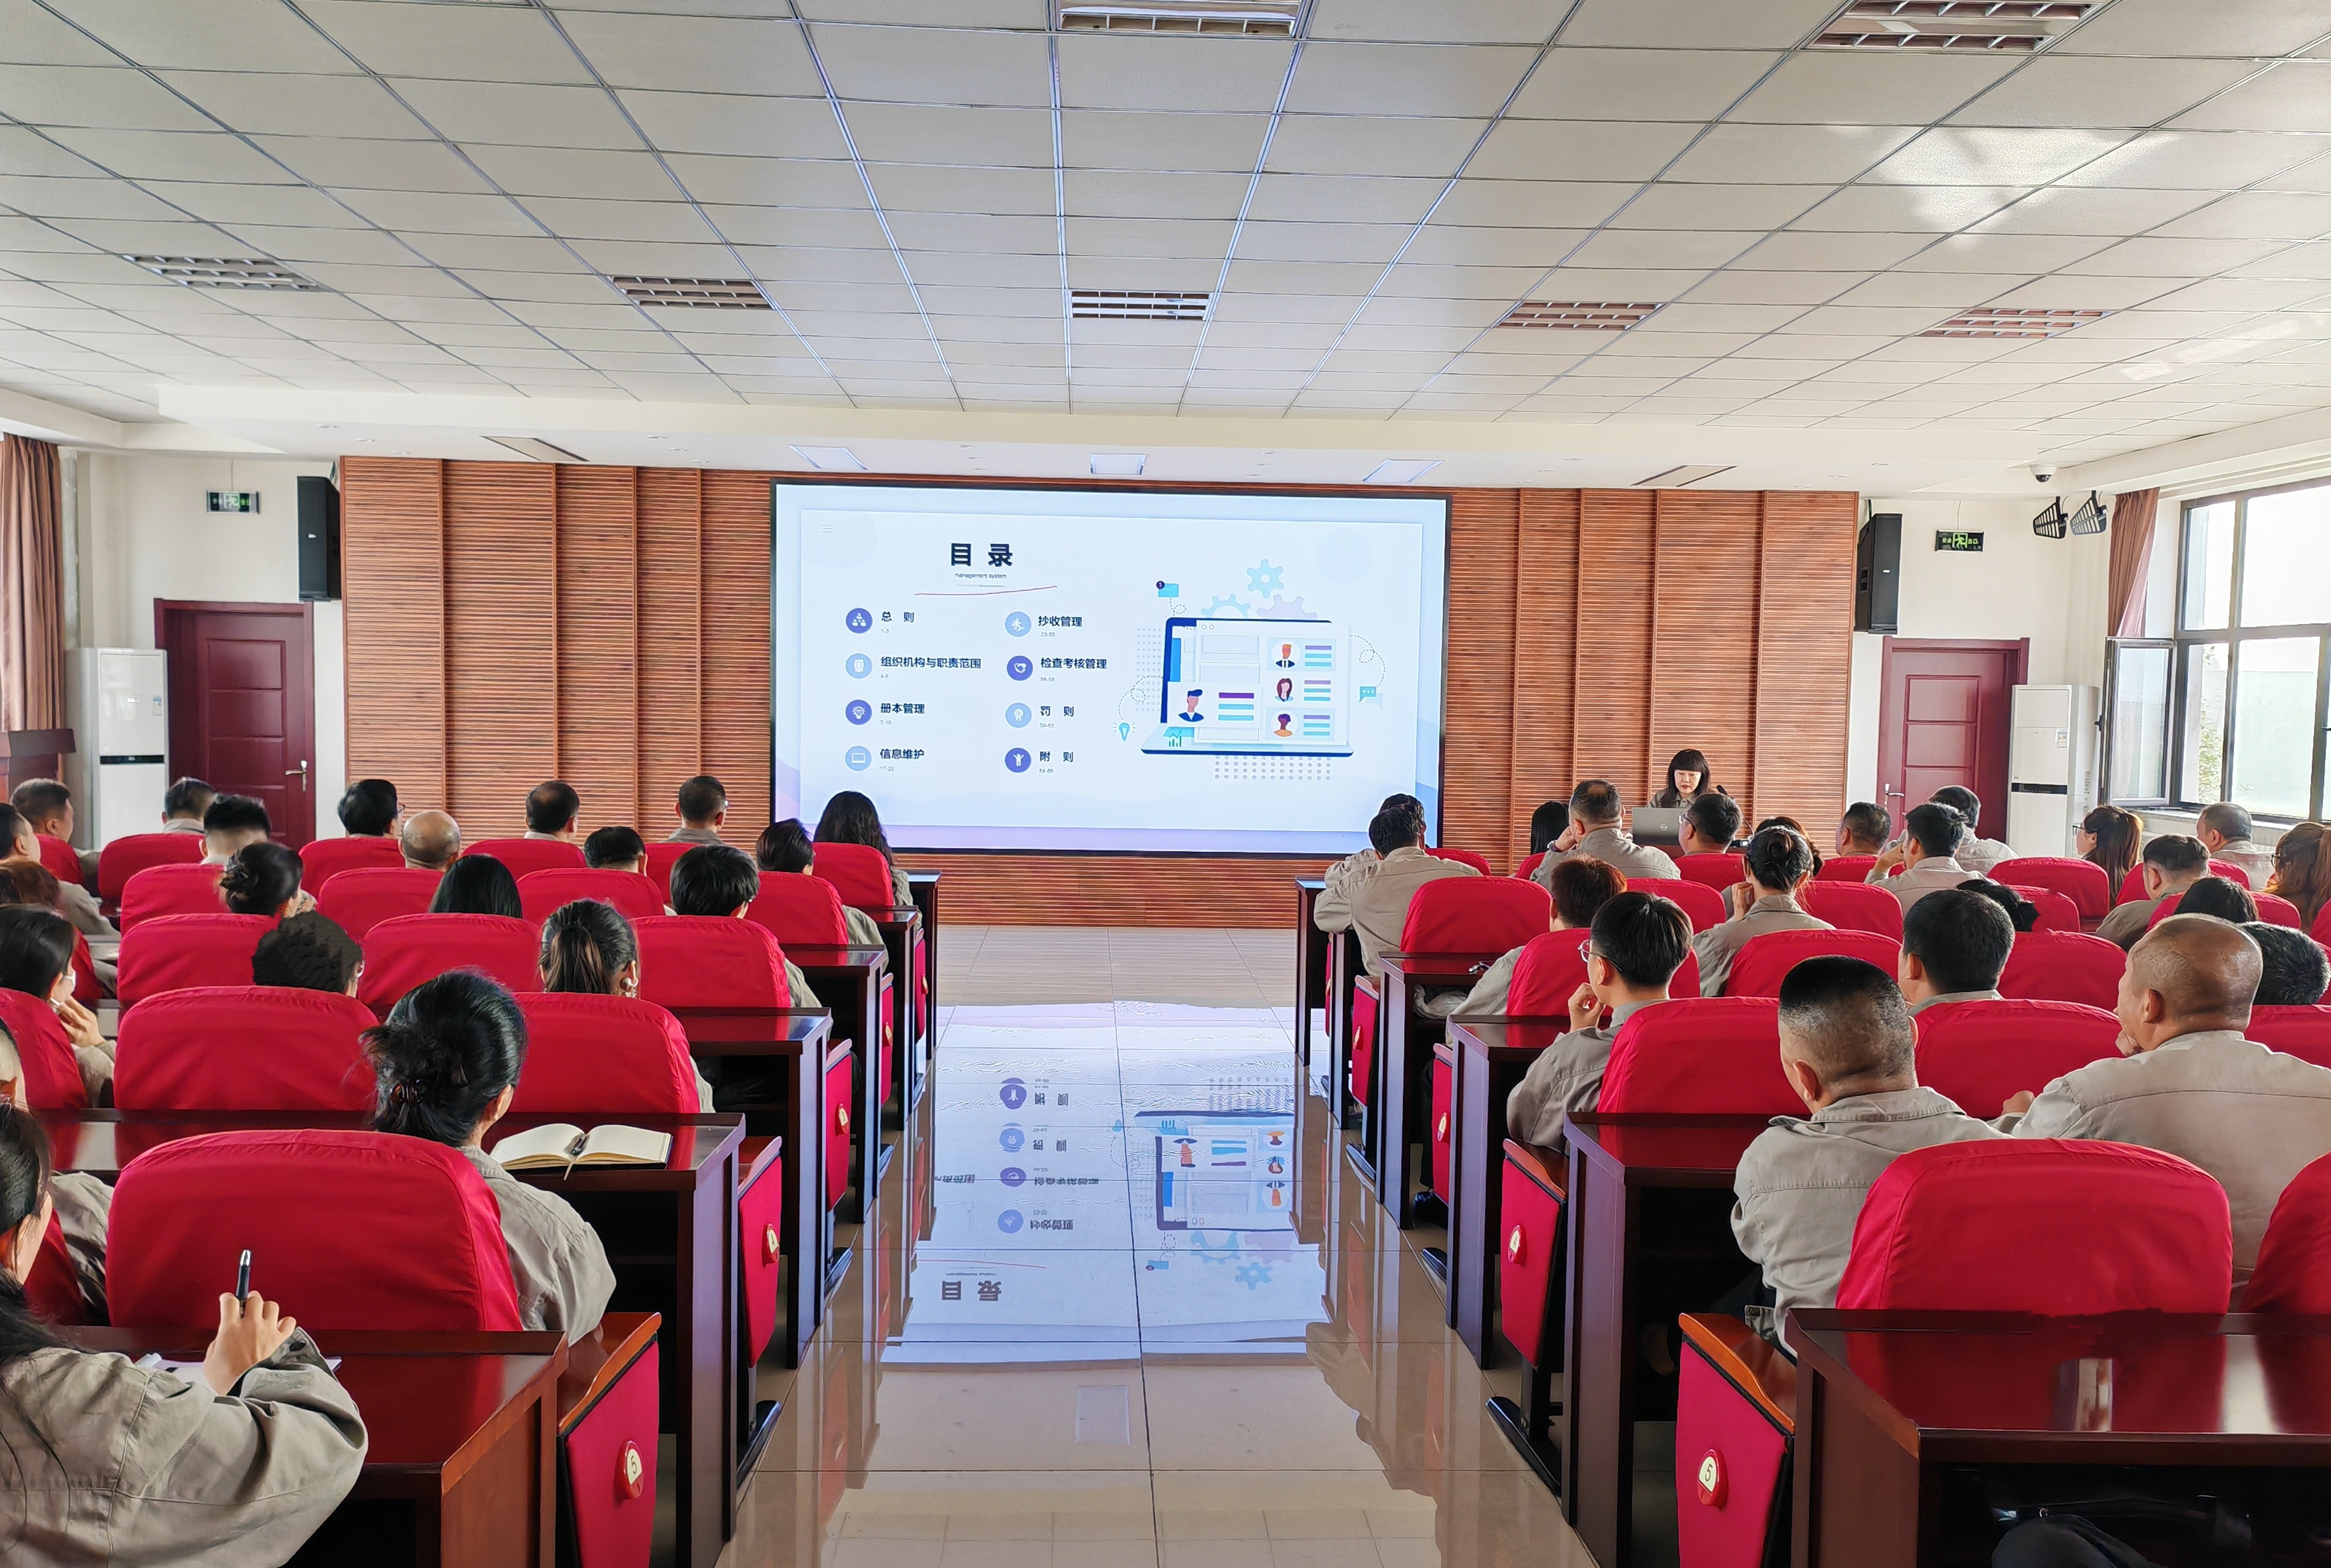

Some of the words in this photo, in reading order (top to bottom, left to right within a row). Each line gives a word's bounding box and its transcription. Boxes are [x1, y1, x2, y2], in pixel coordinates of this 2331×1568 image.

[1037, 615, 1083, 628] 抄收管理
[880, 656, 982, 669] 组织机构与职责范围
[1040, 657, 1107, 670] 检查考核管理
[880, 703, 925, 715] 册本管理
[880, 748, 925, 760] 信息维护
[631, 1455, 637, 1475] 5
[1704, 1463, 1714, 1482] 5
